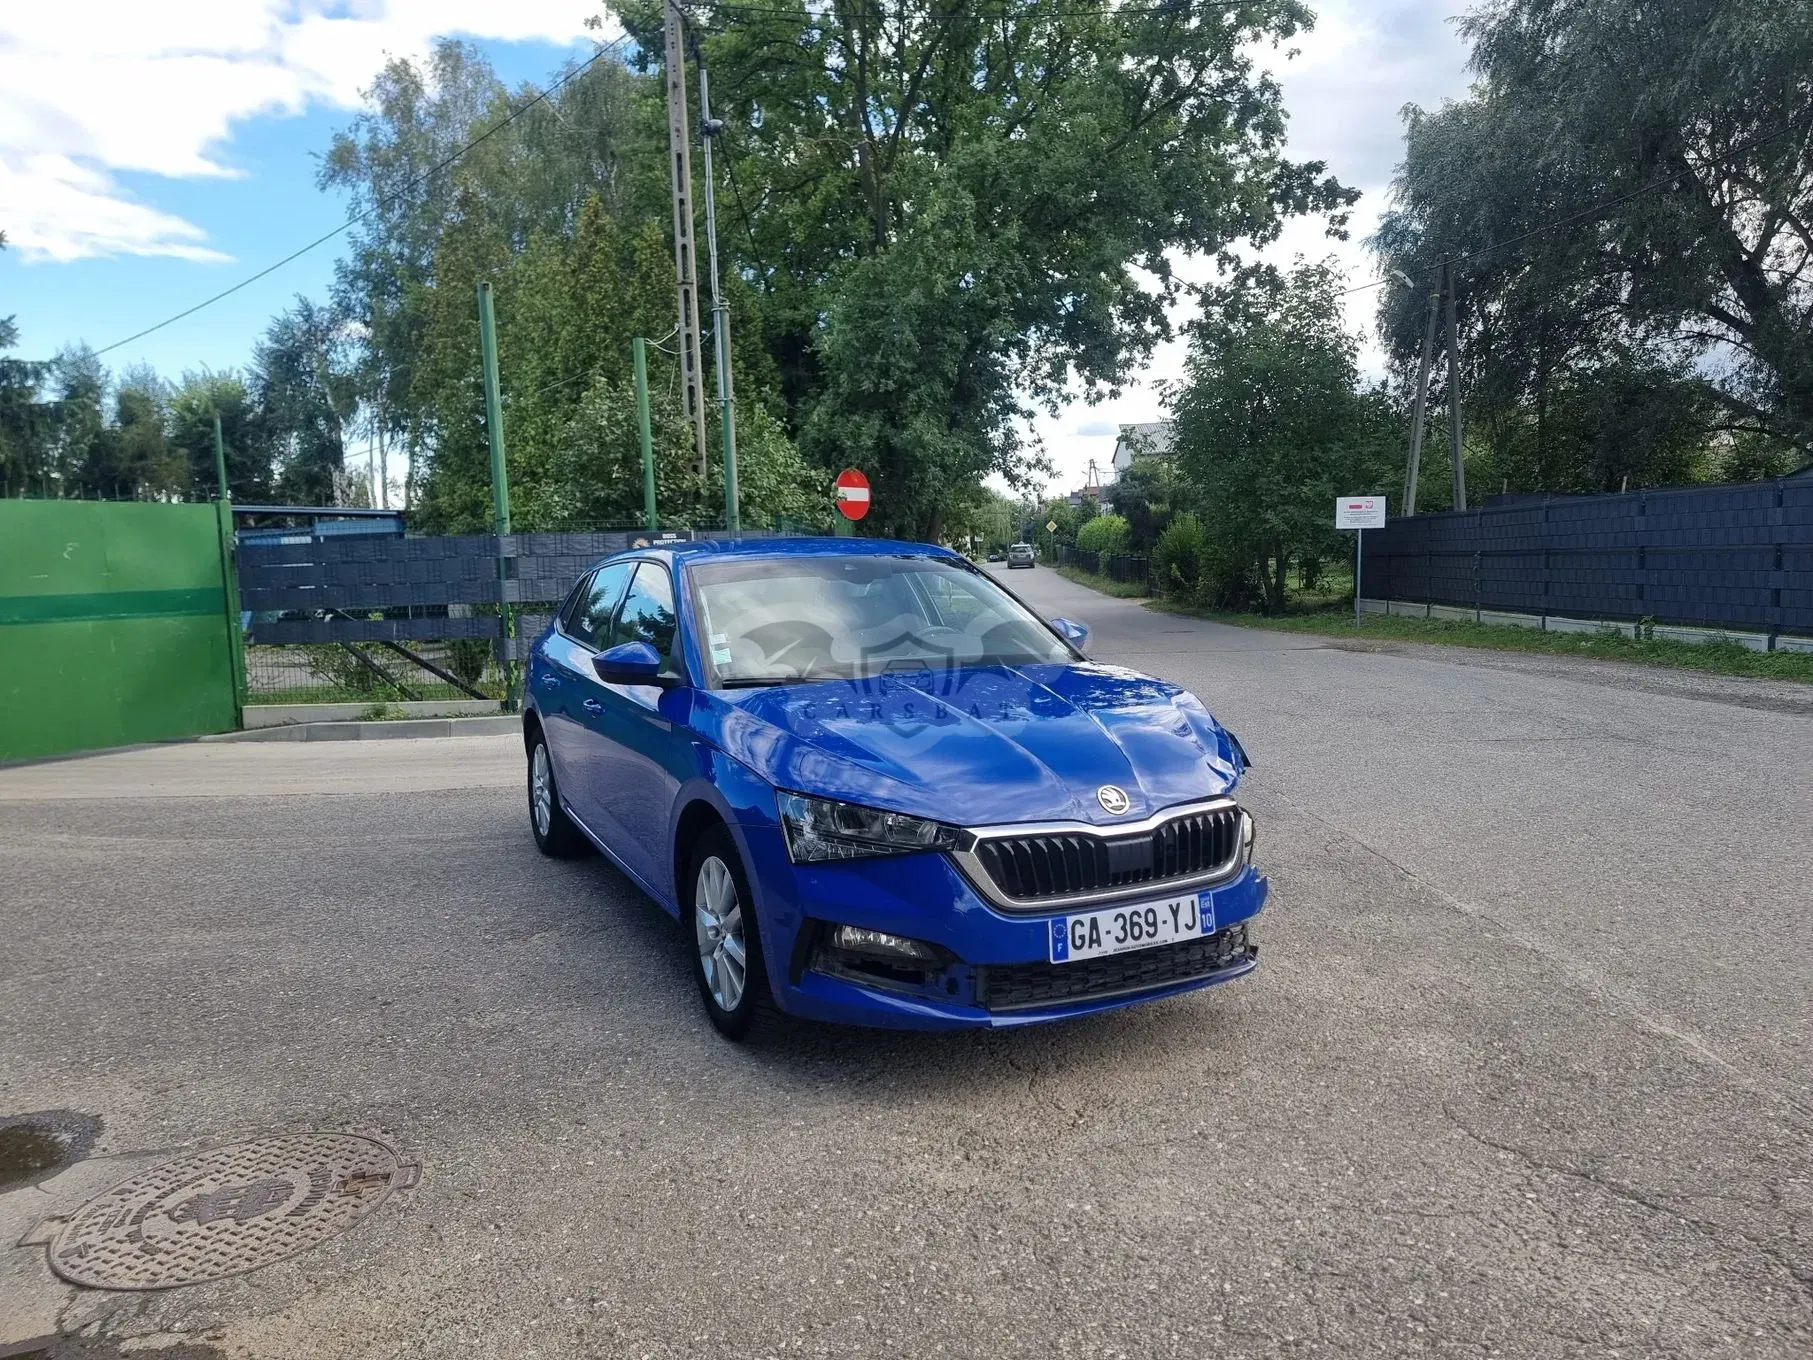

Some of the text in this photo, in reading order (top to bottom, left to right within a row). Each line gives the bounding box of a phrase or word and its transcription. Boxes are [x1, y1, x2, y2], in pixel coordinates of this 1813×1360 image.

[1071, 899, 1197, 951] GA-369-YJ
[1201, 913, 1212, 928] 10
[1057, 942, 1064, 952] F
